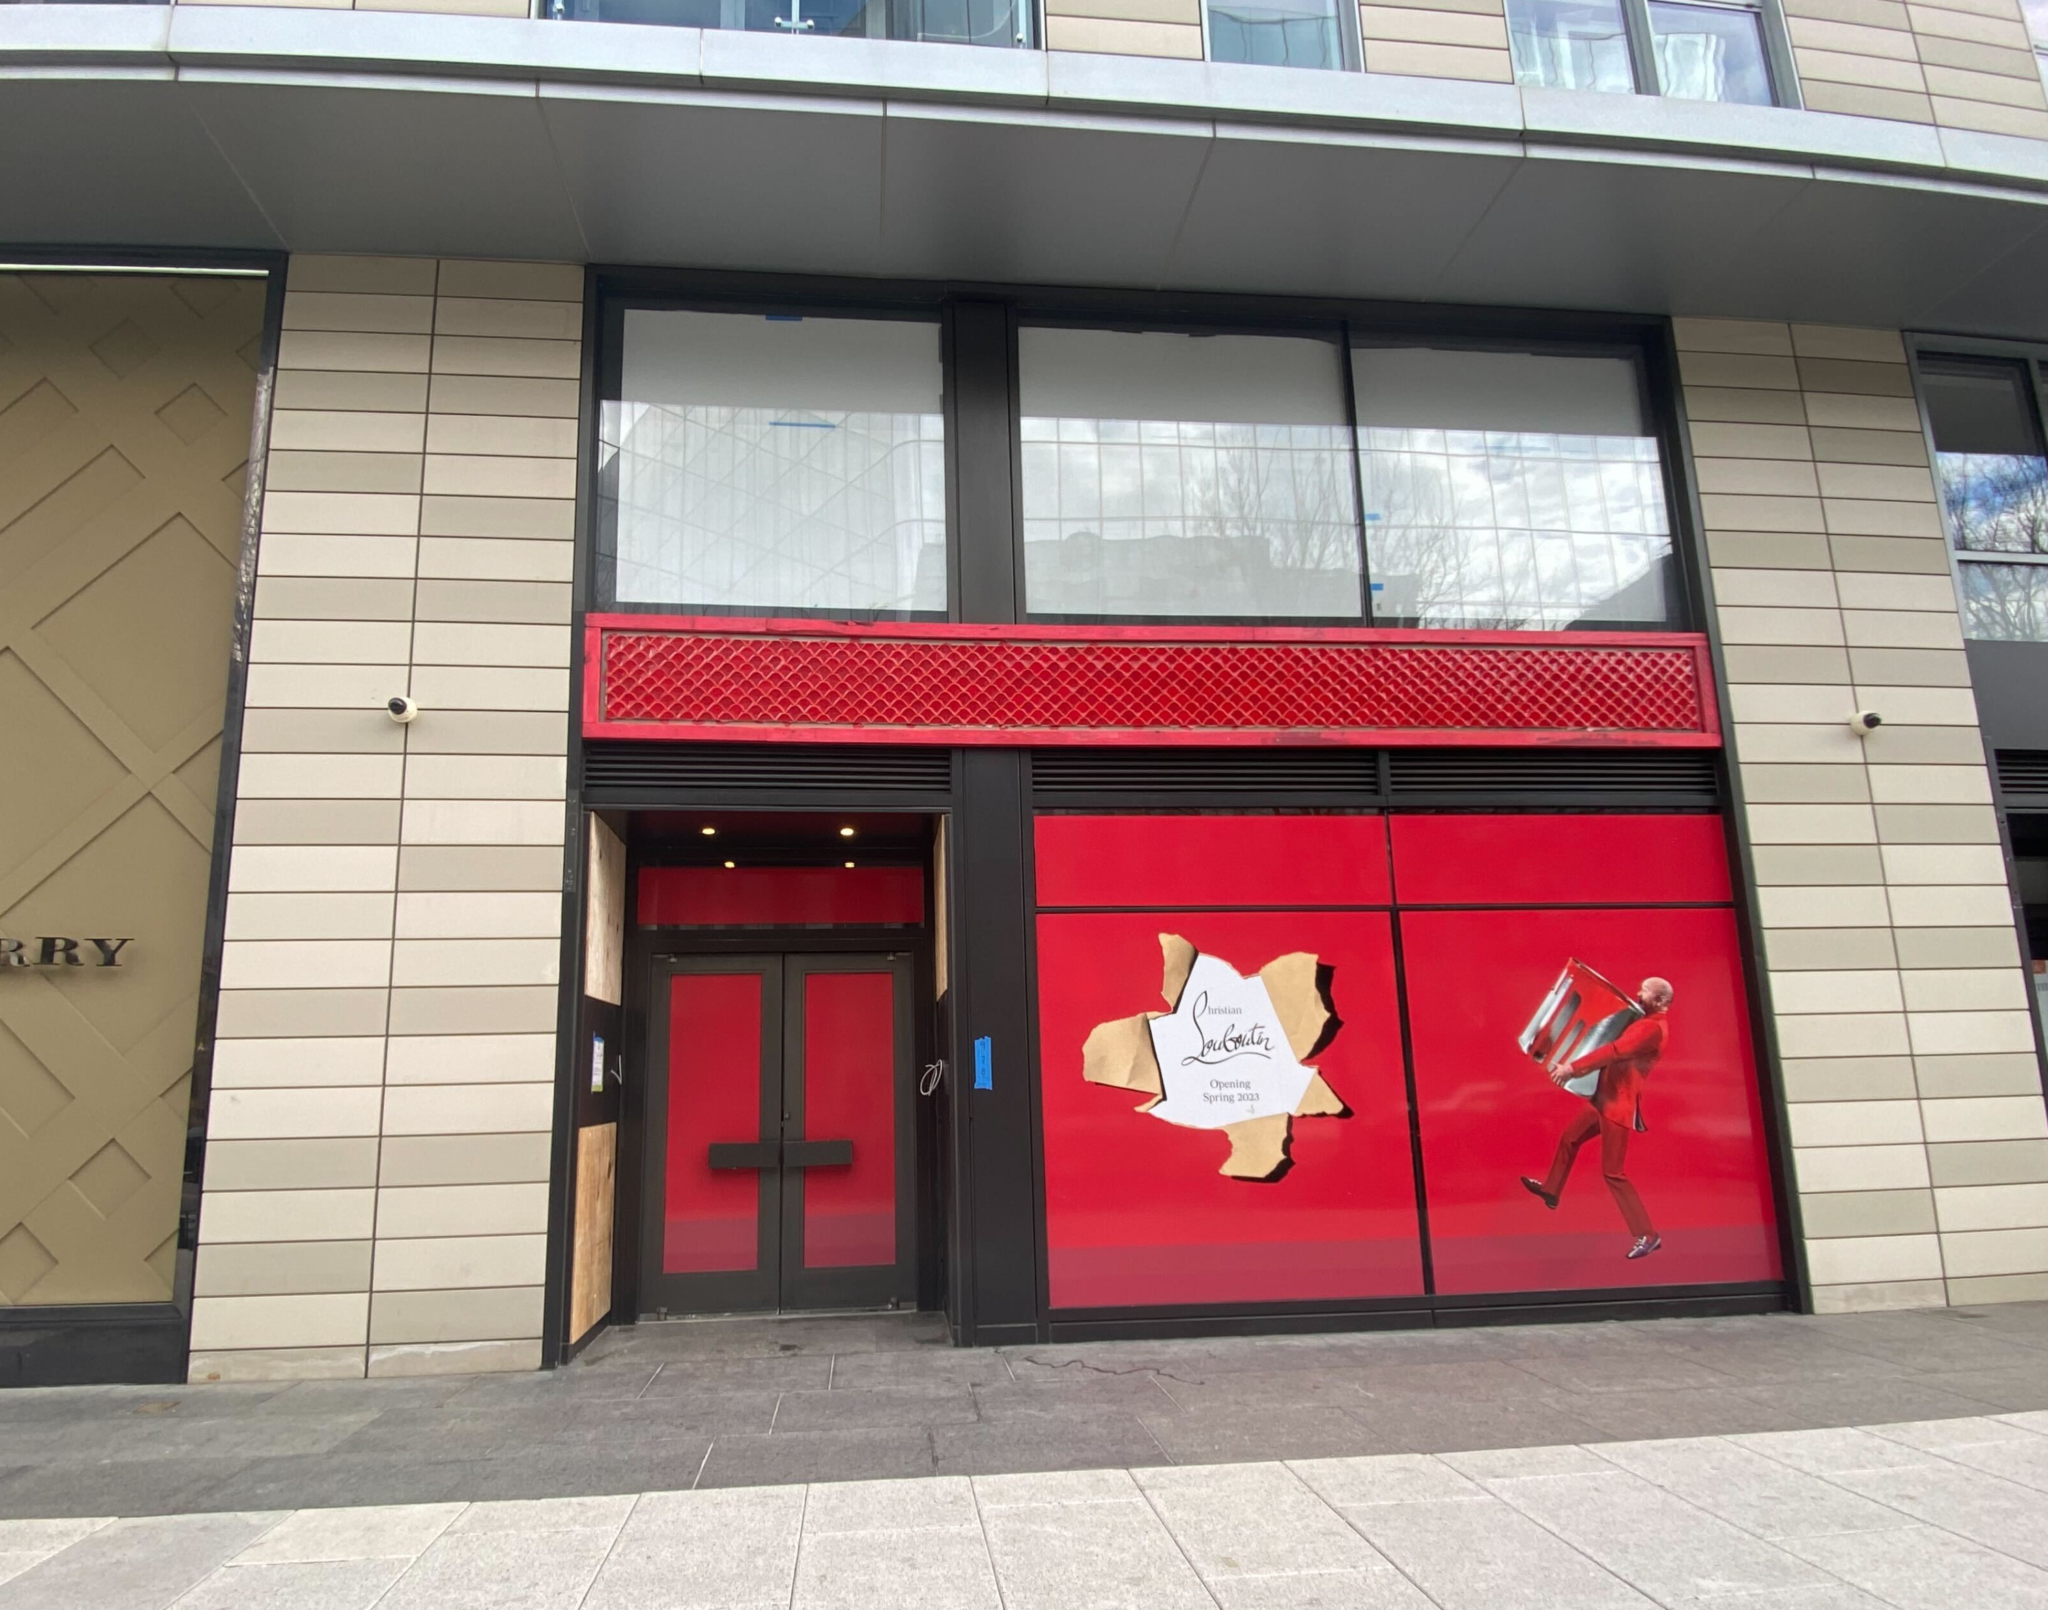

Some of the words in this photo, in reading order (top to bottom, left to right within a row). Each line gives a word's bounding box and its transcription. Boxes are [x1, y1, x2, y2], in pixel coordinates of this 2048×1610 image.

[0, 936, 135, 967] RRY
[1181, 990, 1275, 1066] Louboutin
[979, 1040, 987, 1076] 978
[1203, 1093, 1235, 1104] Spring
[1237, 1093, 1260, 1102] 2023
[1209, 1079, 1251, 1090] Opening
